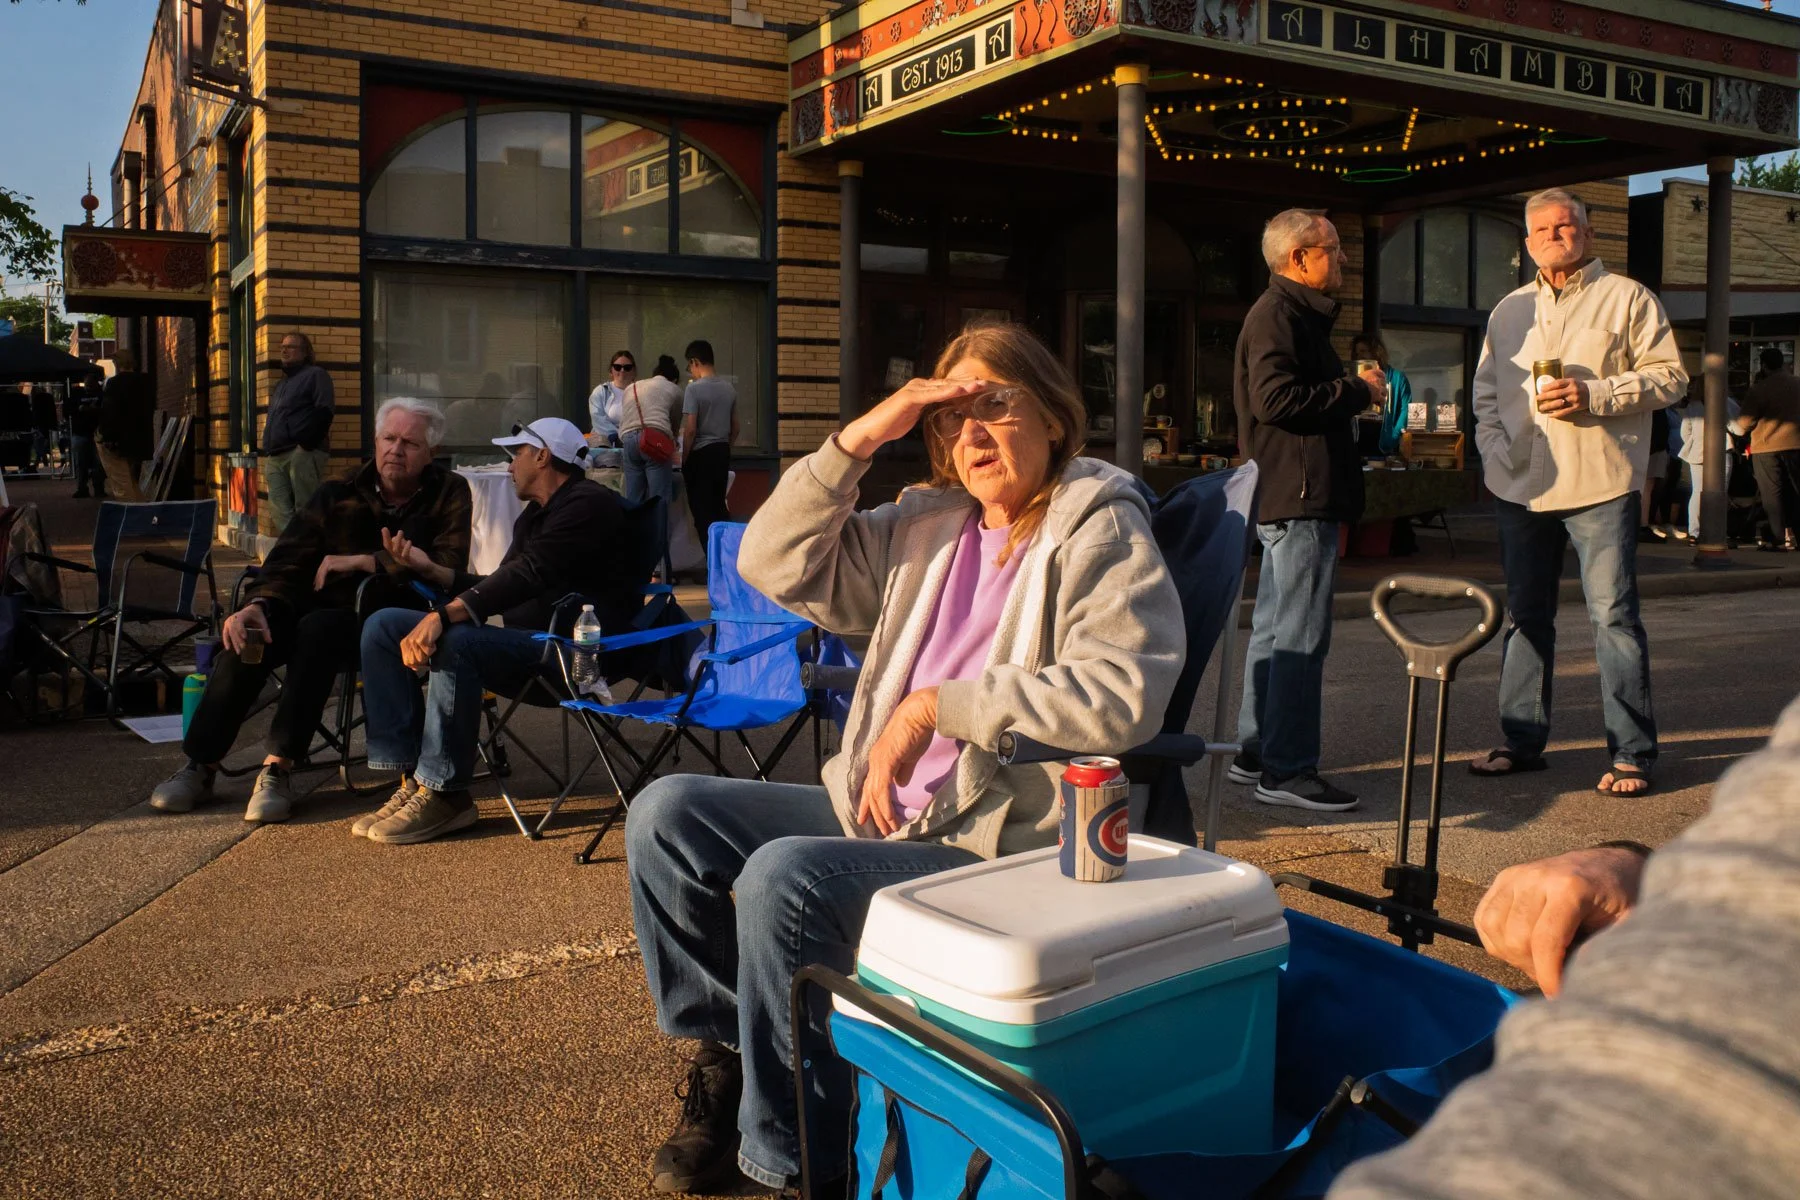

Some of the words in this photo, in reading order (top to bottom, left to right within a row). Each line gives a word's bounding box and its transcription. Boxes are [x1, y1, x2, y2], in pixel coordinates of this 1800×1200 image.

[865, 77, 878, 109] A
[935, 48, 963, 80] 1913
[988, 23, 1005, 61] A
